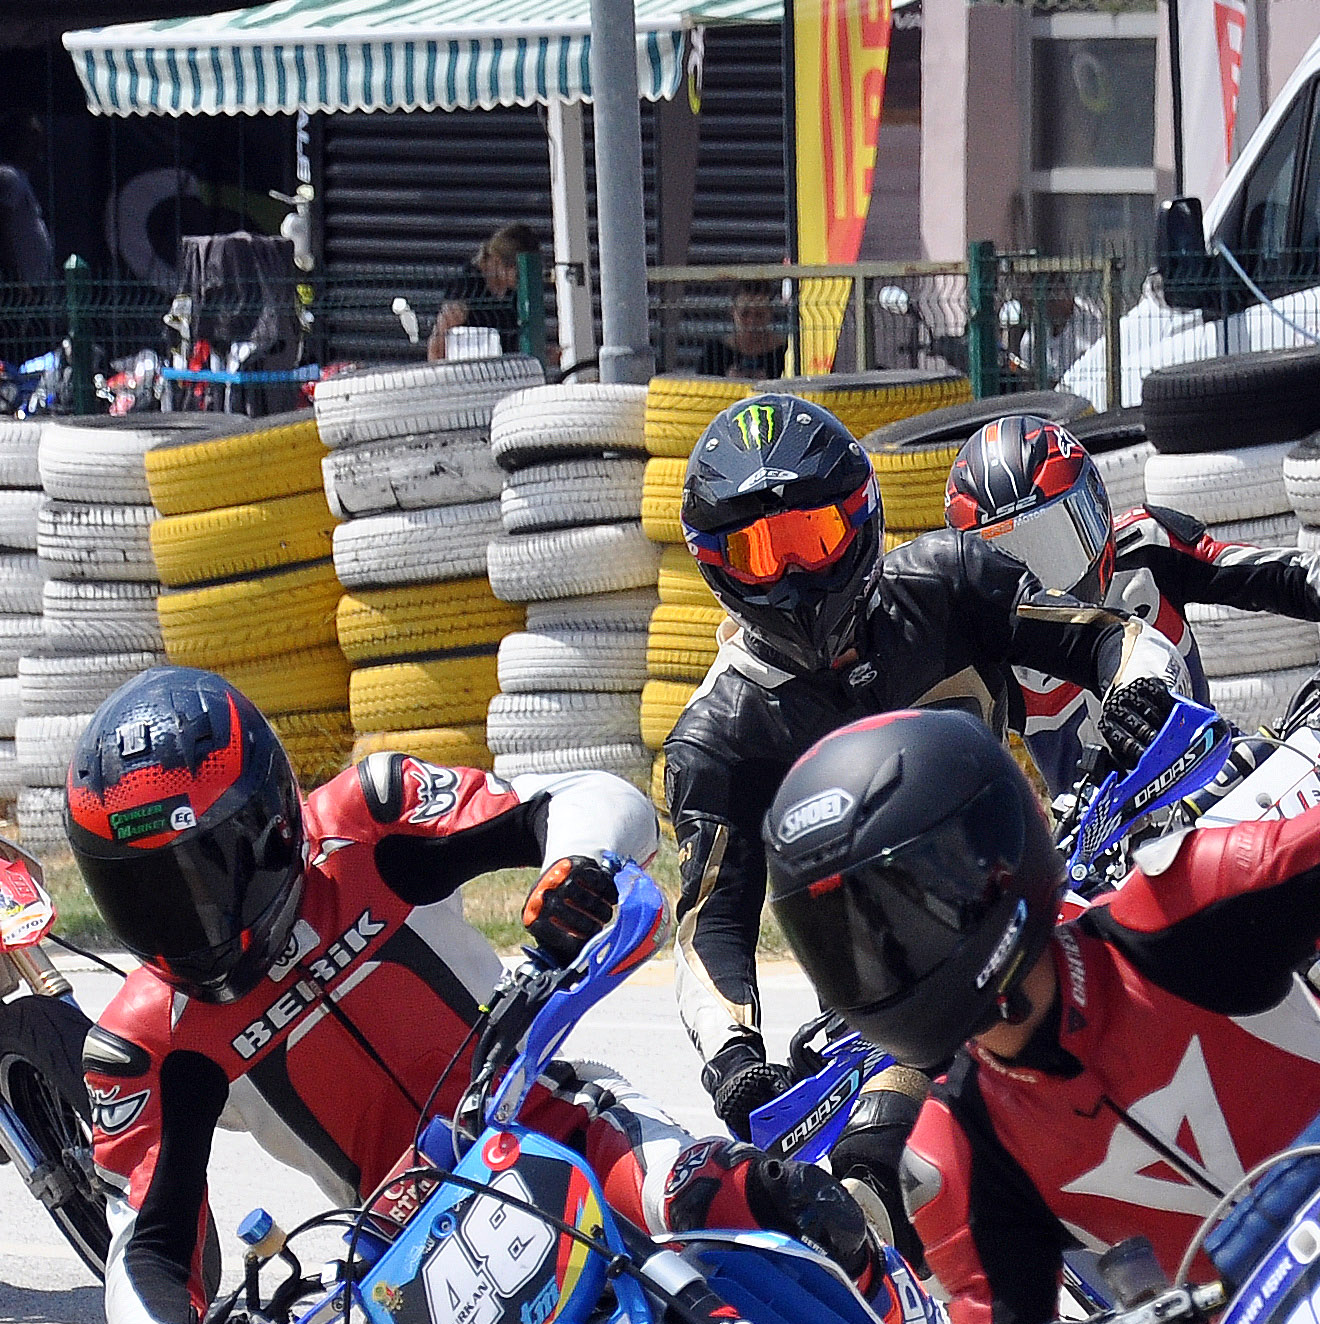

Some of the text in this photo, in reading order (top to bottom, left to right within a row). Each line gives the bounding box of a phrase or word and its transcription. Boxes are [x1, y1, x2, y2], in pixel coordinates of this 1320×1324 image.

[980, 493, 1038, 525] LS2
[1134, 750, 1198, 809] DADAS
[785, 793, 842, 837] SHOEI
[781, 1094, 842, 1154] DADAS
